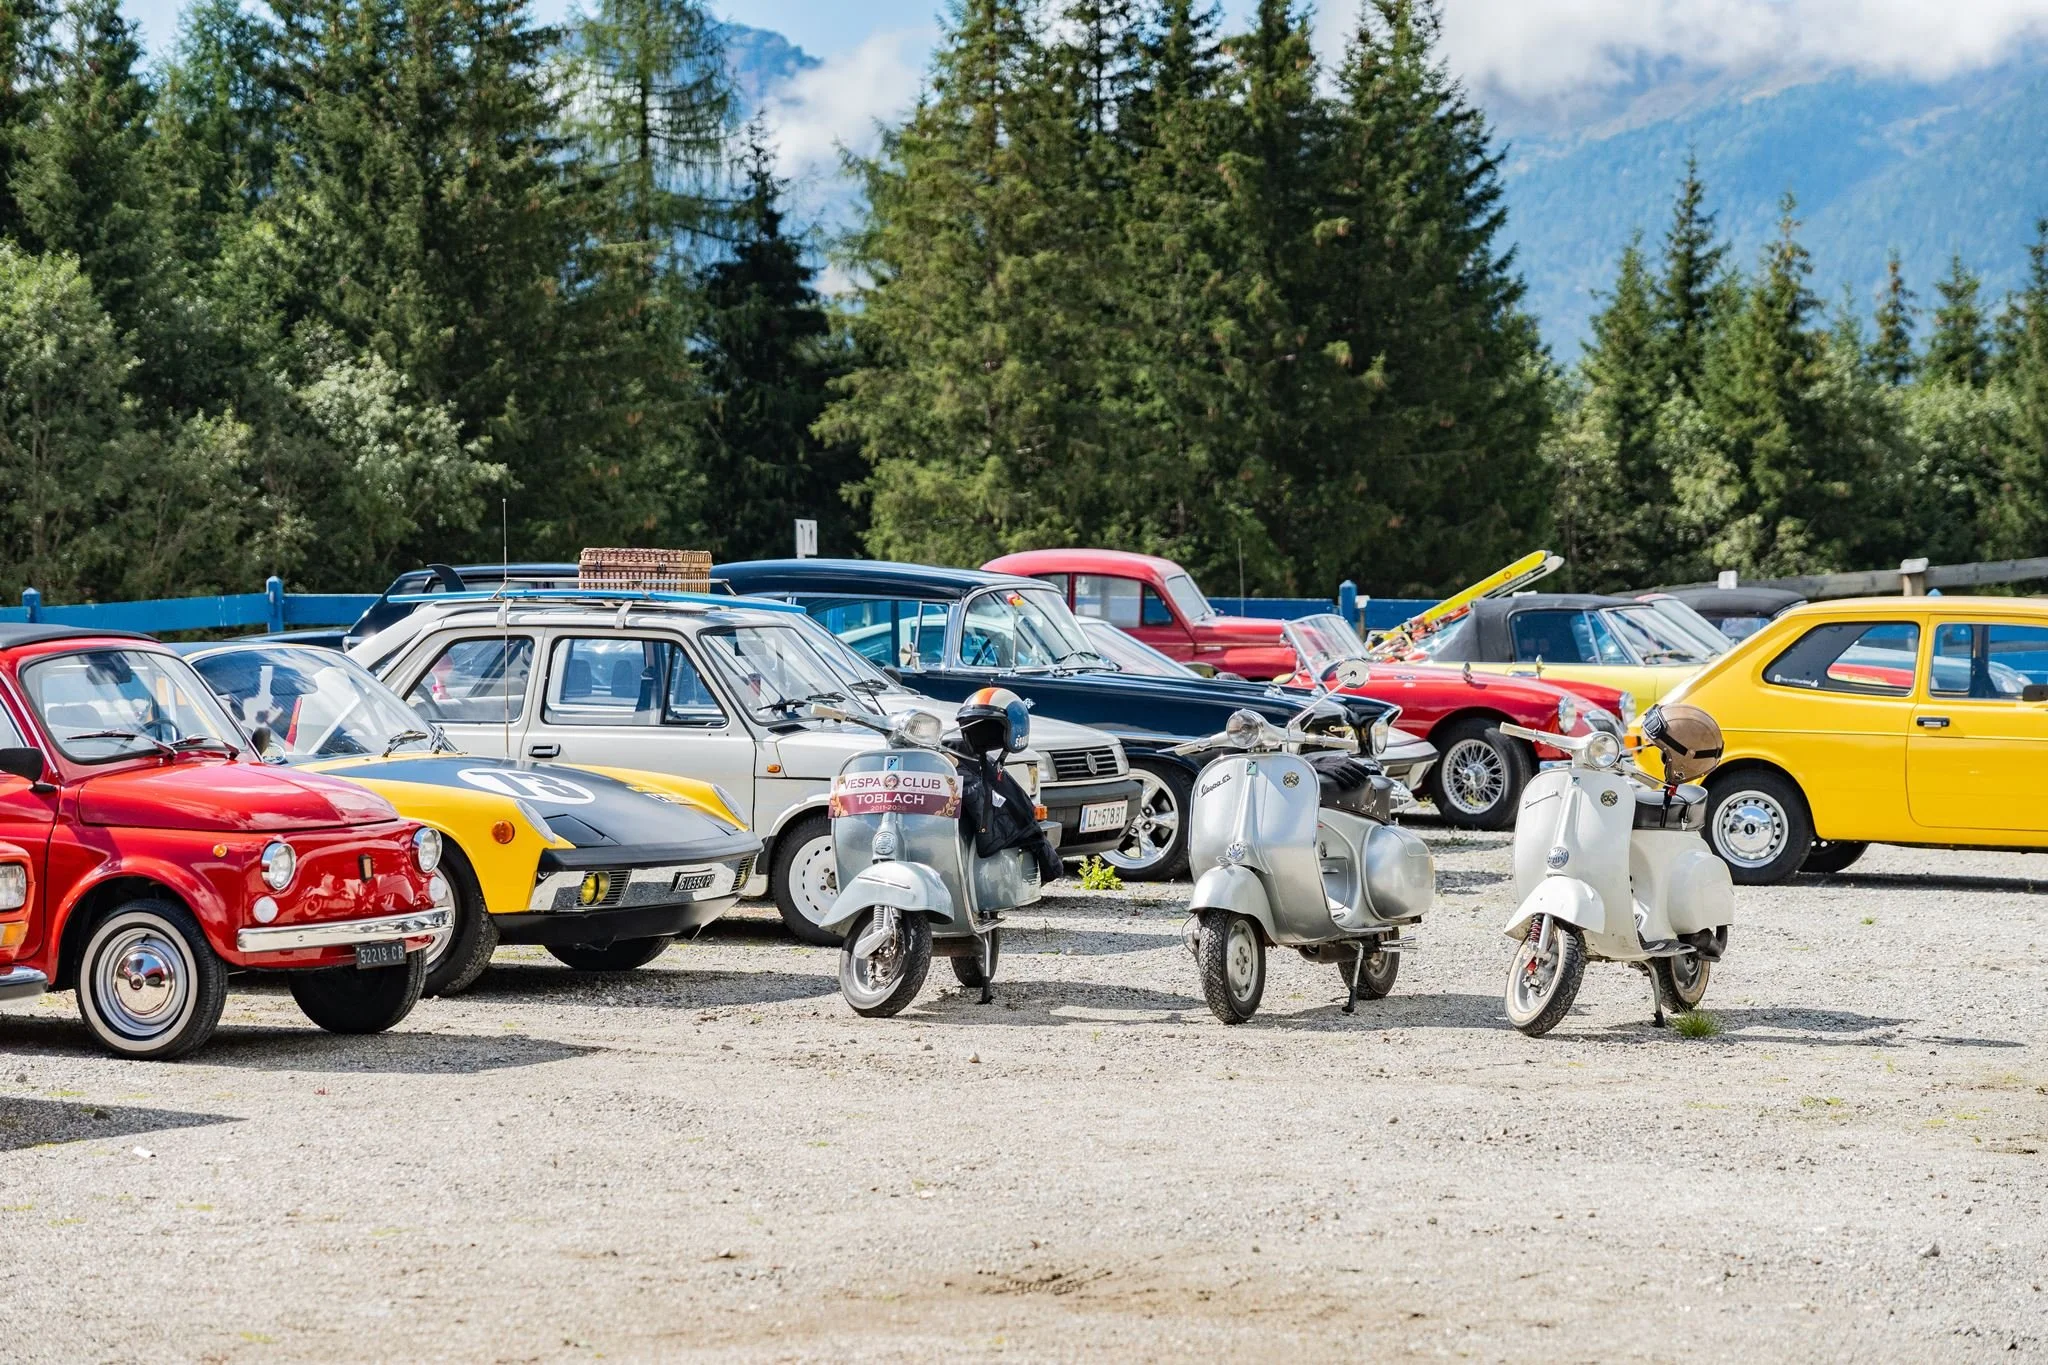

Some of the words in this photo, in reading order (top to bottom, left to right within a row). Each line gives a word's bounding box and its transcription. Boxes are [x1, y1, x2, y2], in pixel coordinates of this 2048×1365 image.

[845, 778, 881, 790] VESPA
[903, 777, 941, 790] CLUB
[857, 793, 924, 805] TOBLACH
[360, 947, 388, 964] 52219
